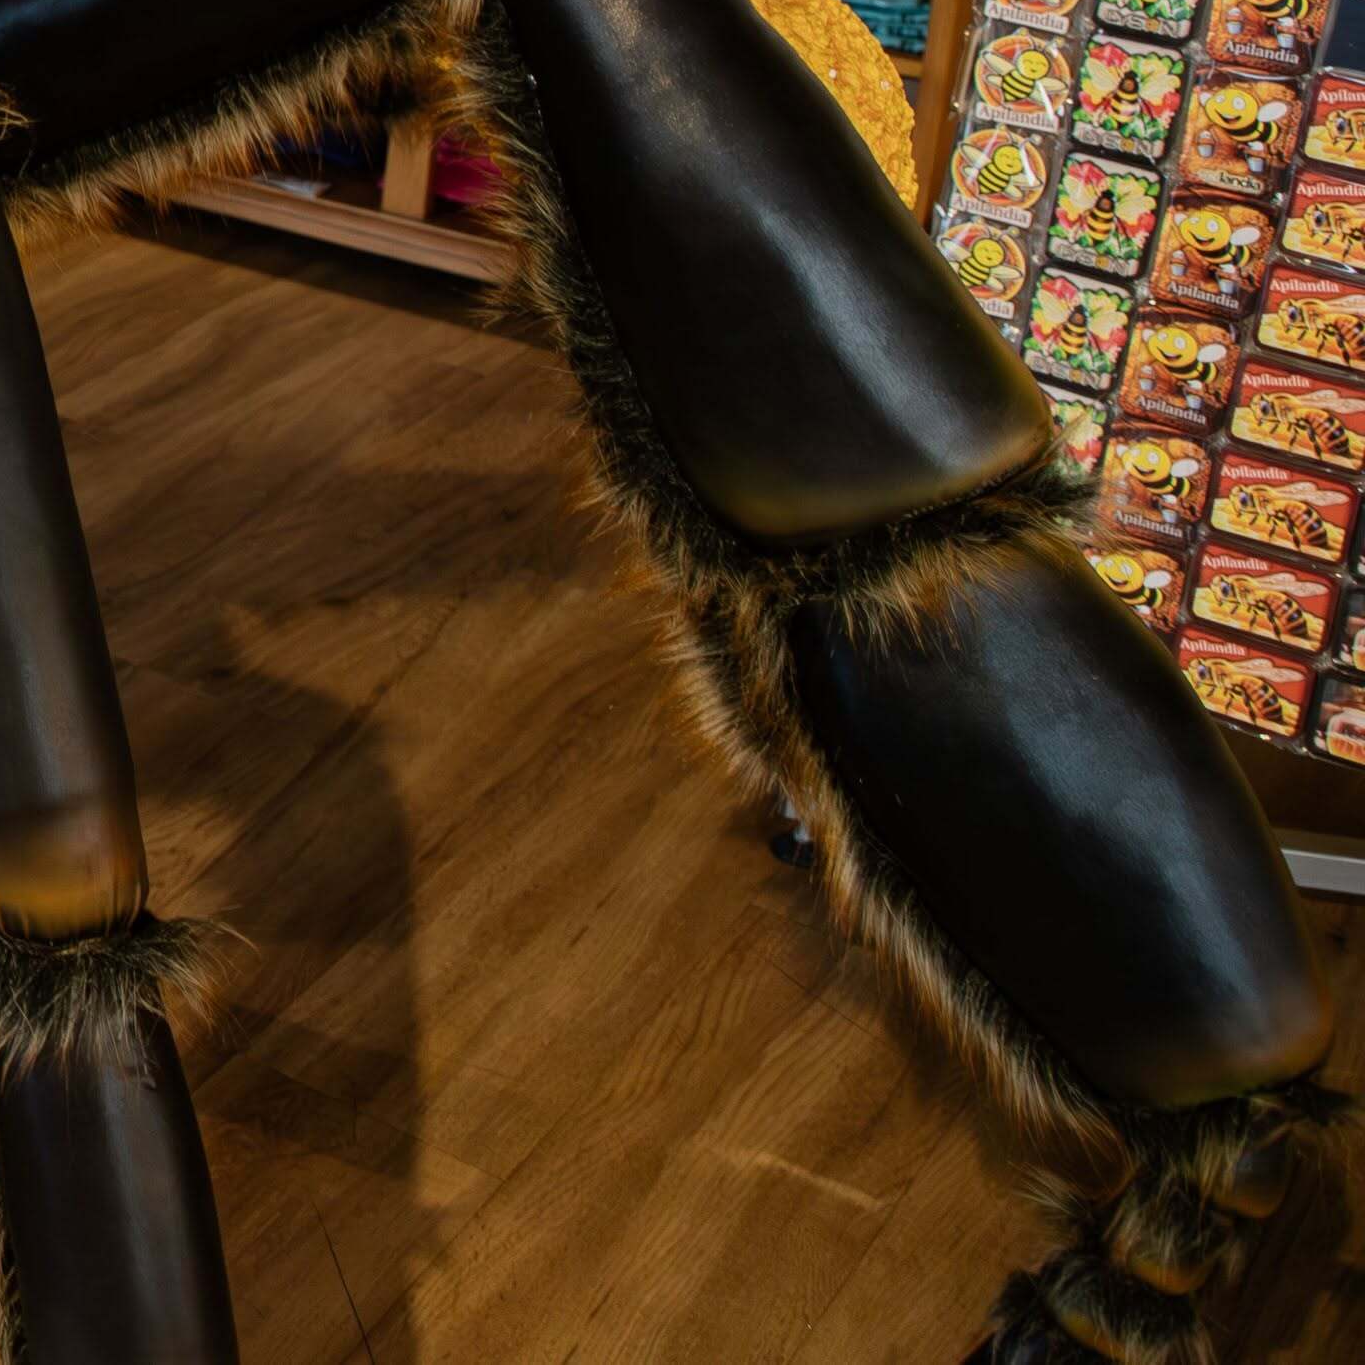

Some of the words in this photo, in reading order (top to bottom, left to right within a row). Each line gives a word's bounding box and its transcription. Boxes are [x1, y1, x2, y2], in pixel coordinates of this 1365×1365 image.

[988, 4, 1065, 31] Apilandia
[1103, 8, 1180, 38] LYSON
[1224, 40, 1299, 65] Apilandia
[1318, 88, 1365, 104] Apilan
[978, 104, 1056, 129] Apilandia
[1078, 126, 1154, 156] LYSON
[952, 194, 1030, 226] Apilandia
[1057, 241, 1134, 275] LYSON
[1168, 280, 1239, 310] Apilandia
[1269, 277, 1340, 295] Apilandia
[1241, 373, 1311, 388] Apilandia
[1135, 394, 1207, 426] Apilandia
[1220, 464, 1288, 481] Apilandia
[1114, 509, 1183, 538] Apilandia
[1201, 554, 1269, 572] Apilandia
[1180, 637, 1246, 657] Apilandia
